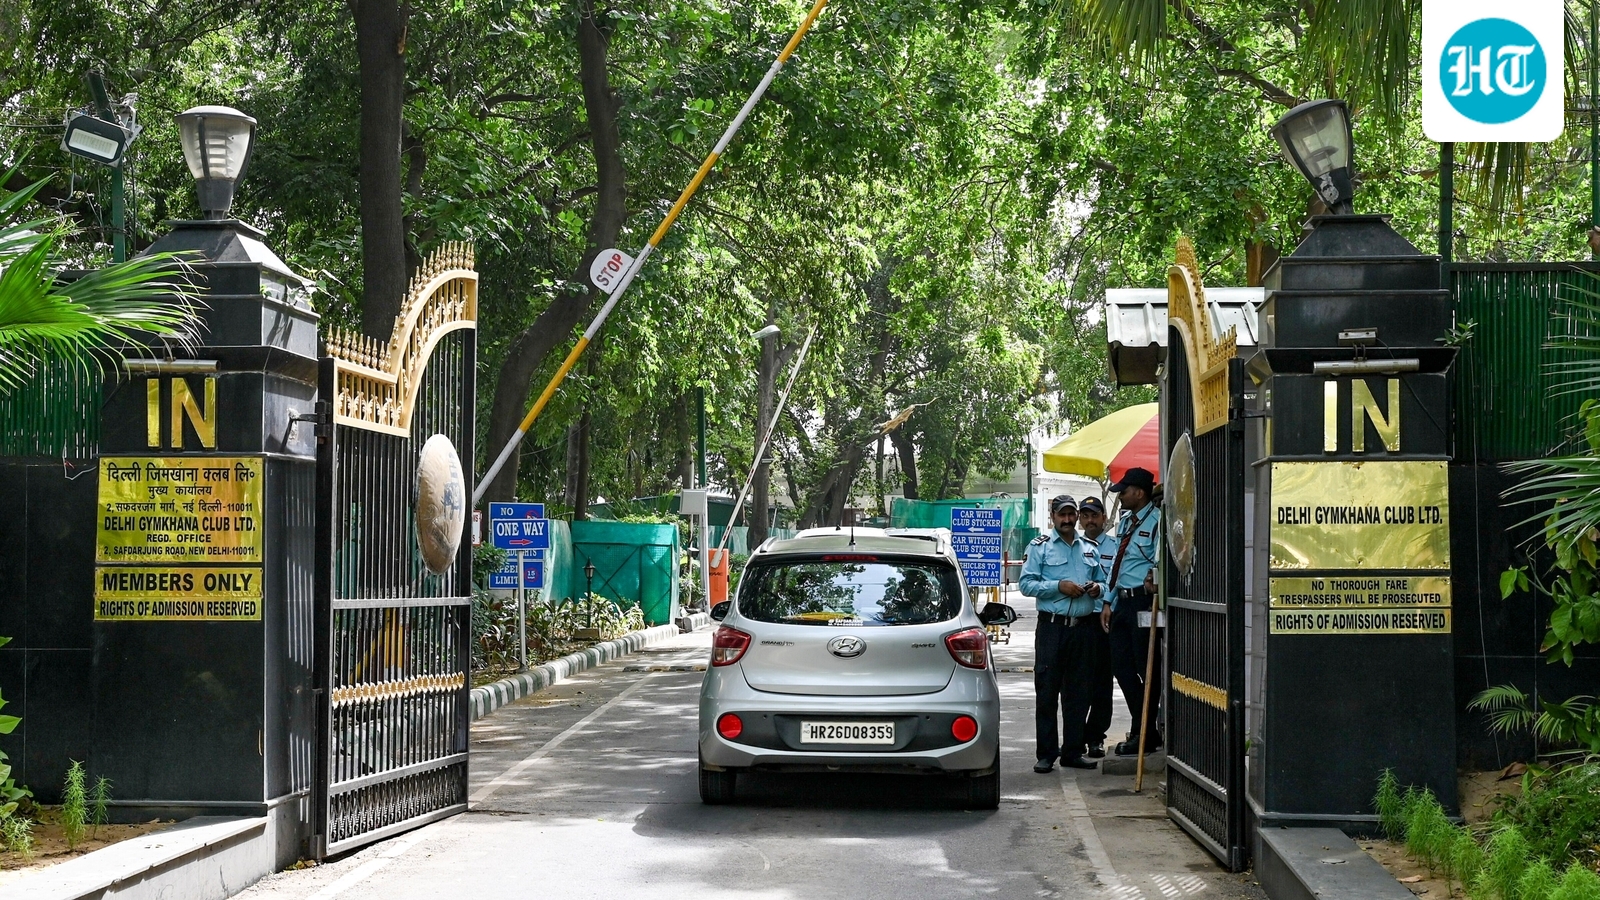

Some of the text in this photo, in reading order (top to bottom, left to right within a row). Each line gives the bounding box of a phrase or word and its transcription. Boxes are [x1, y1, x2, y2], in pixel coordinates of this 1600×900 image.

[596, 253, 623, 286] STOP
[147, 377, 216, 448] IN
[1324, 379, 1400, 452] IN
[107, 462, 141, 482] दिल्ली
[146, 462, 198, 482] जिमखाना
[203, 467, 230, 482] क्लब
[148, 482, 212, 499] मुख्य कार्यालय
[182, 500, 194, 512] नई
[500, 507, 514, 516] NO
[960, 510, 993, 519] CAR WITH
[1277, 506, 1443, 524] DELHI GYMKHANA CLUB LTD.
[104, 516, 256, 531] DELHI GYMKHANA CLUB LTD.
[496, 522, 545, 536] ONE WAY
[952, 518, 1000, 528] CLUB STICKER
[146, 533, 212, 543] REGD. OFFICE
[952, 536, 1000, 545] CAR WITHOUT
[104, 546, 254, 556] 2, SAFDARJUNG ROAD, NEW DELHI-110011
[970, 545, 1000, 553] STICKER
[103, 573, 253, 592] MEMBERS ONLY
[971, 577, 1000, 585] BARRIER
[1311, 579, 1408, 591] NO THOROUGH FARE
[1279, 593, 1441, 605] TRESPASSERS WILL BE PROSECUTED
[100, 601, 256, 616] RIGHTS OF ADMISSION RESERVED
[1276, 613, 1446, 630] RIGHTS OF ADMISSION RESERVED
[810, 725, 893, 739] HR26DQ8359
